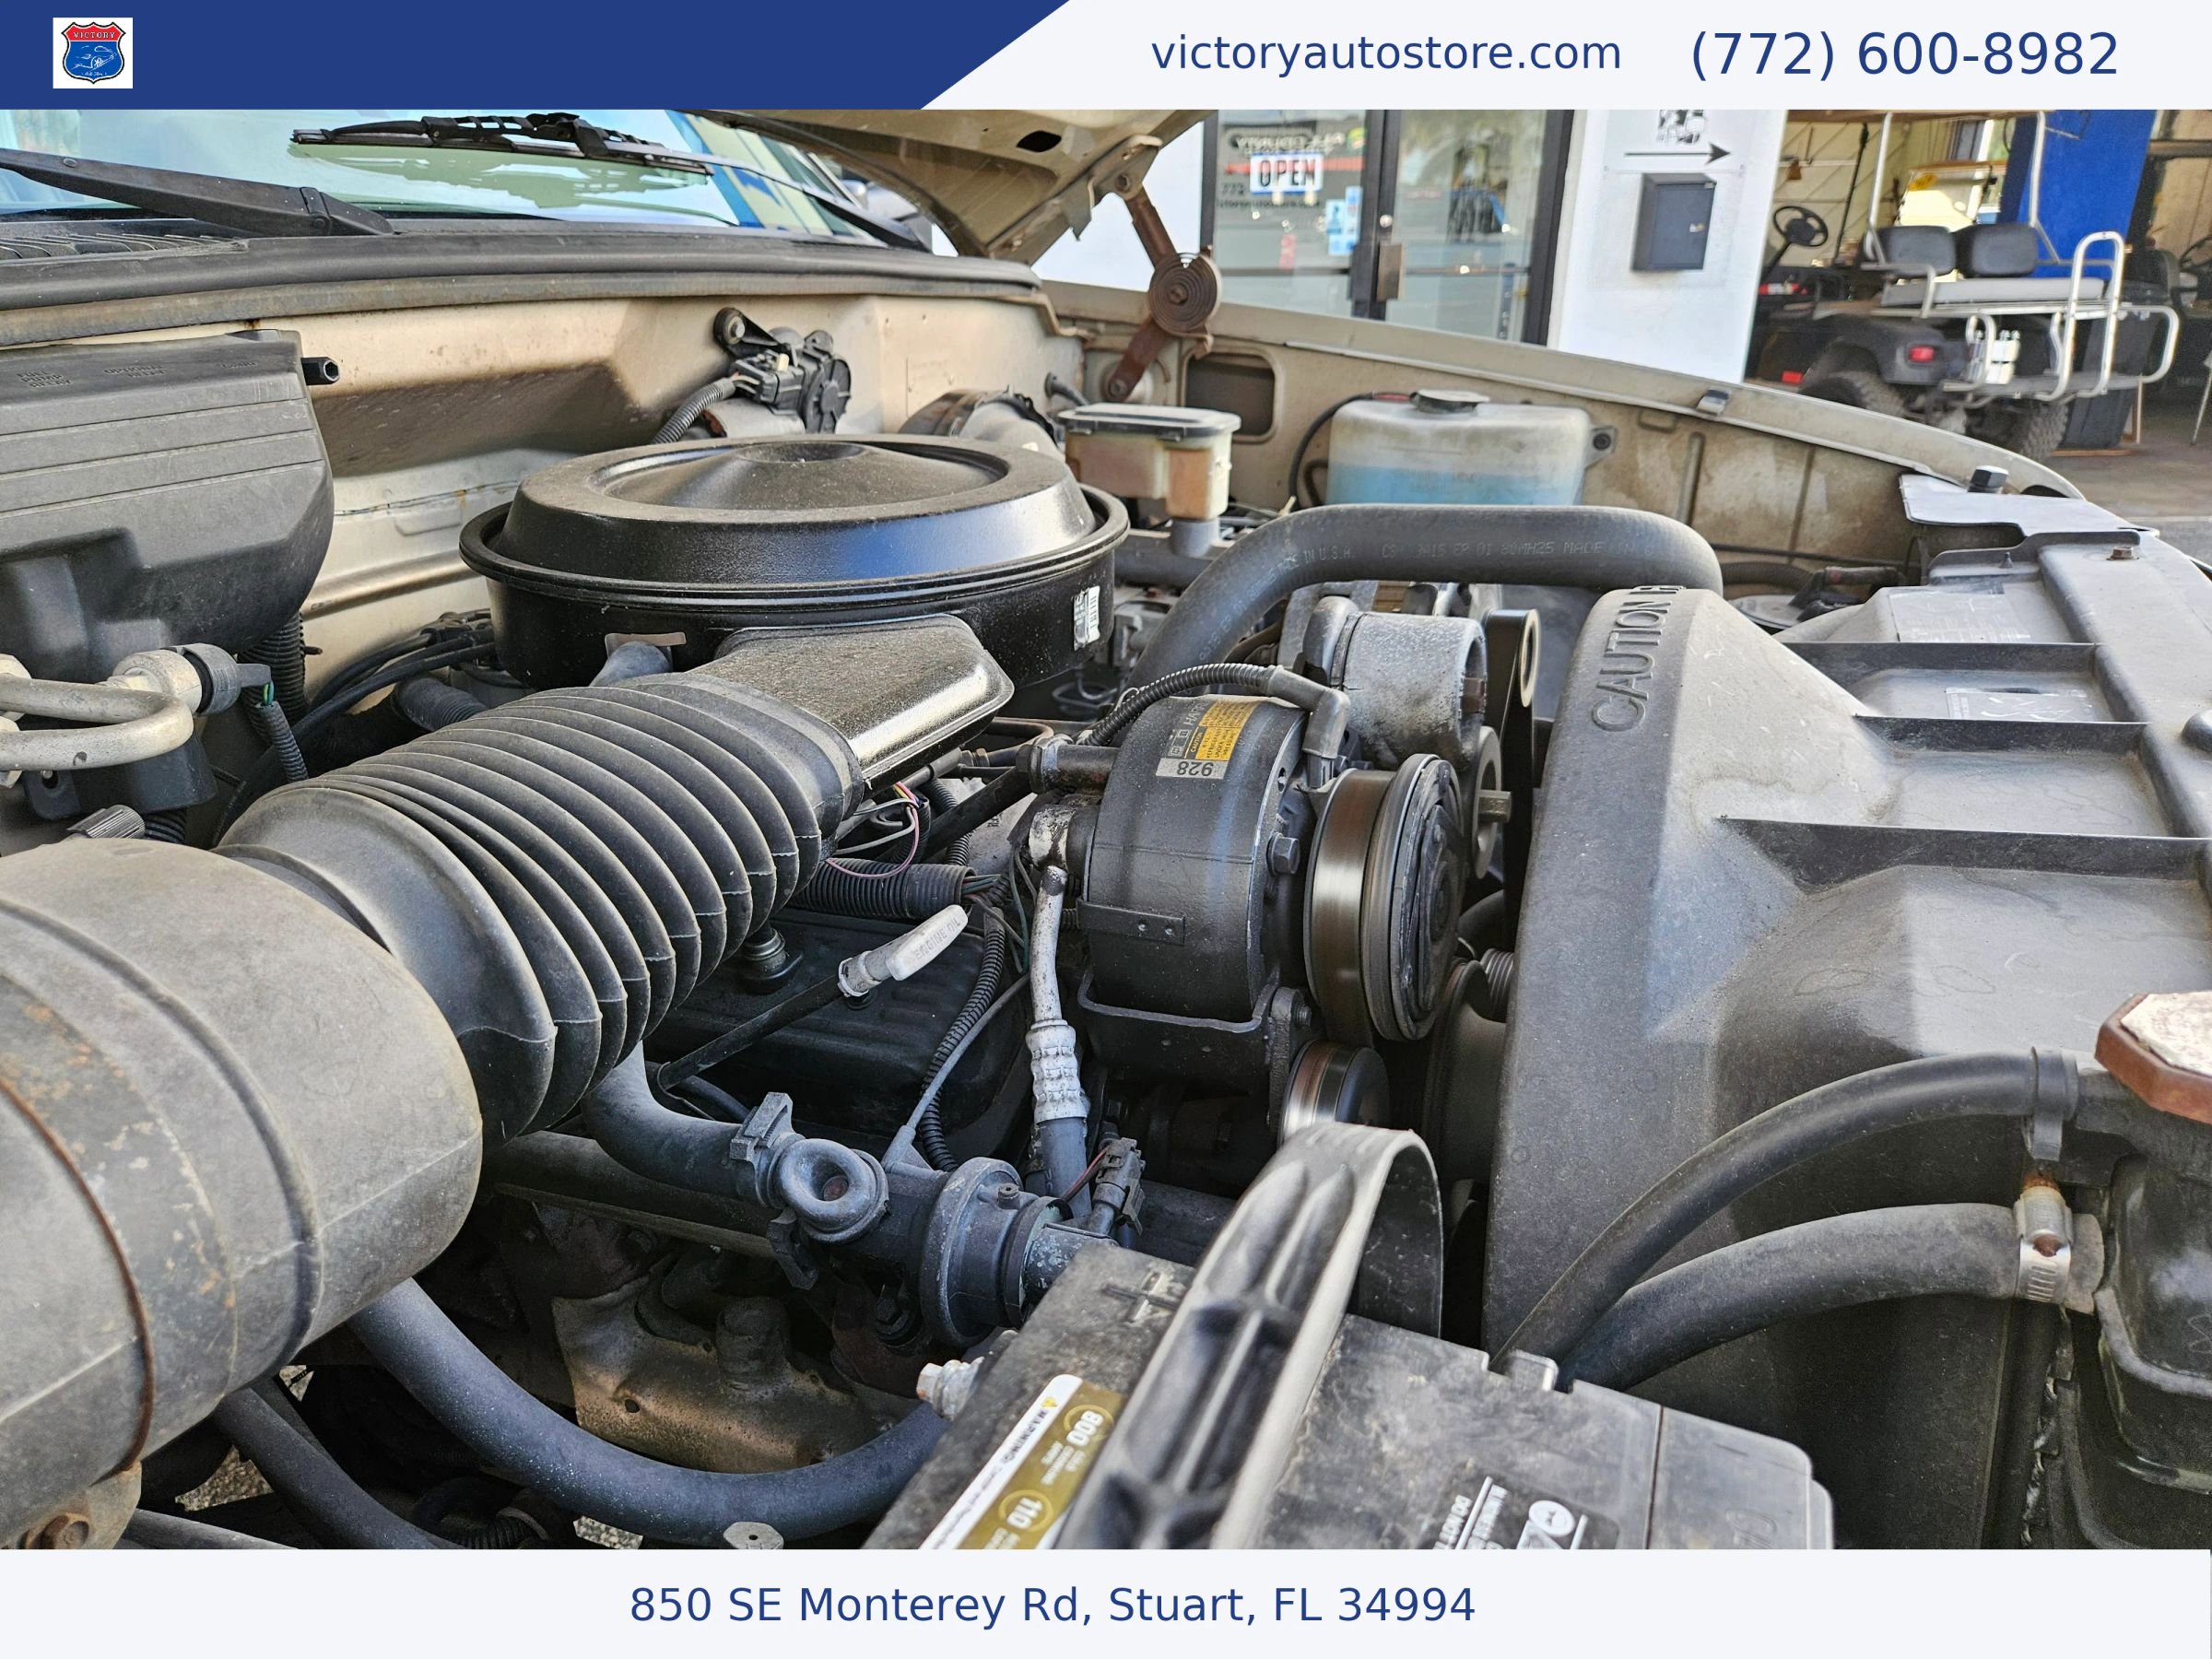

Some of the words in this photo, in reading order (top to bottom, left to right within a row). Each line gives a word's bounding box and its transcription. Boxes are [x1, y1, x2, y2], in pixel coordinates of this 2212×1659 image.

[1259, 159, 1316, 187] OPEN
[1591, 600, 1673, 733] CAUTION
[1176, 760, 1214, 777] 928
[915, 928, 947, 959] ENGINE
[947, 915, 960, 932] OIL
[1065, 1409, 1104, 1447] 800
[1006, 1497, 1043, 1530] 110
